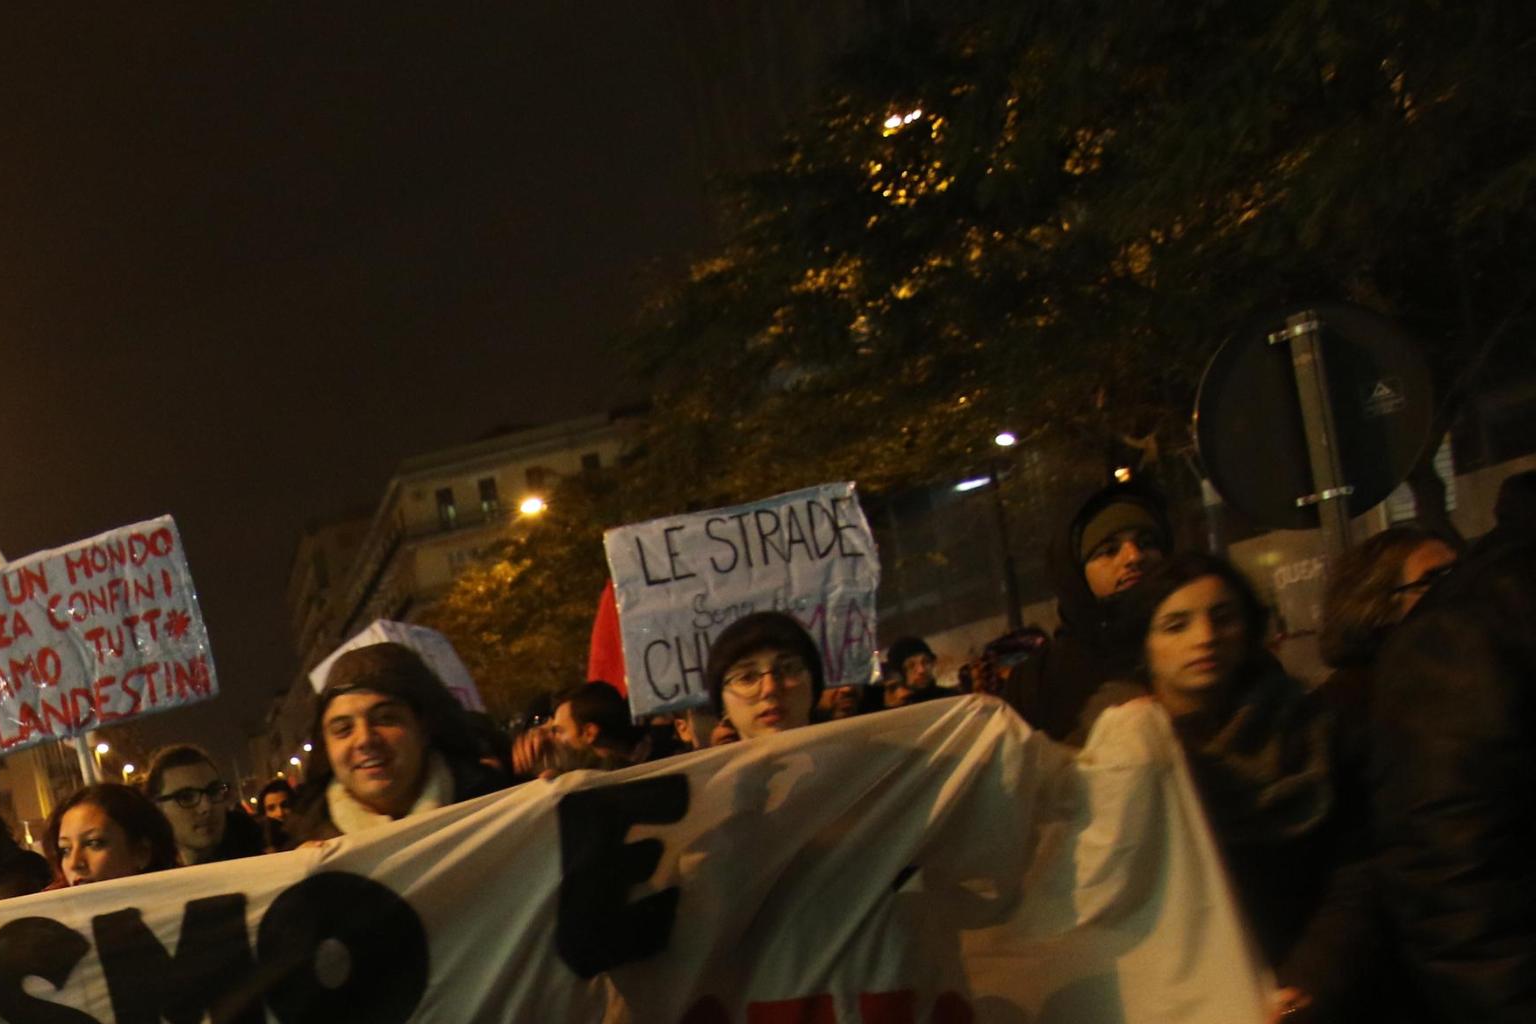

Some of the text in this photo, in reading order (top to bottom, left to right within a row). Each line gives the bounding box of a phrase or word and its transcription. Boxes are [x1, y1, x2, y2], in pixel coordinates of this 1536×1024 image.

[1, 562, 49, 606] UN
[64, 527, 174, 585] MONDO
[634, 496, 865, 586] LE STRADE
[47, 569, 173, 631] CONFINI
[643, 630, 716, 702] CH
[556, 774, 690, 980] E
